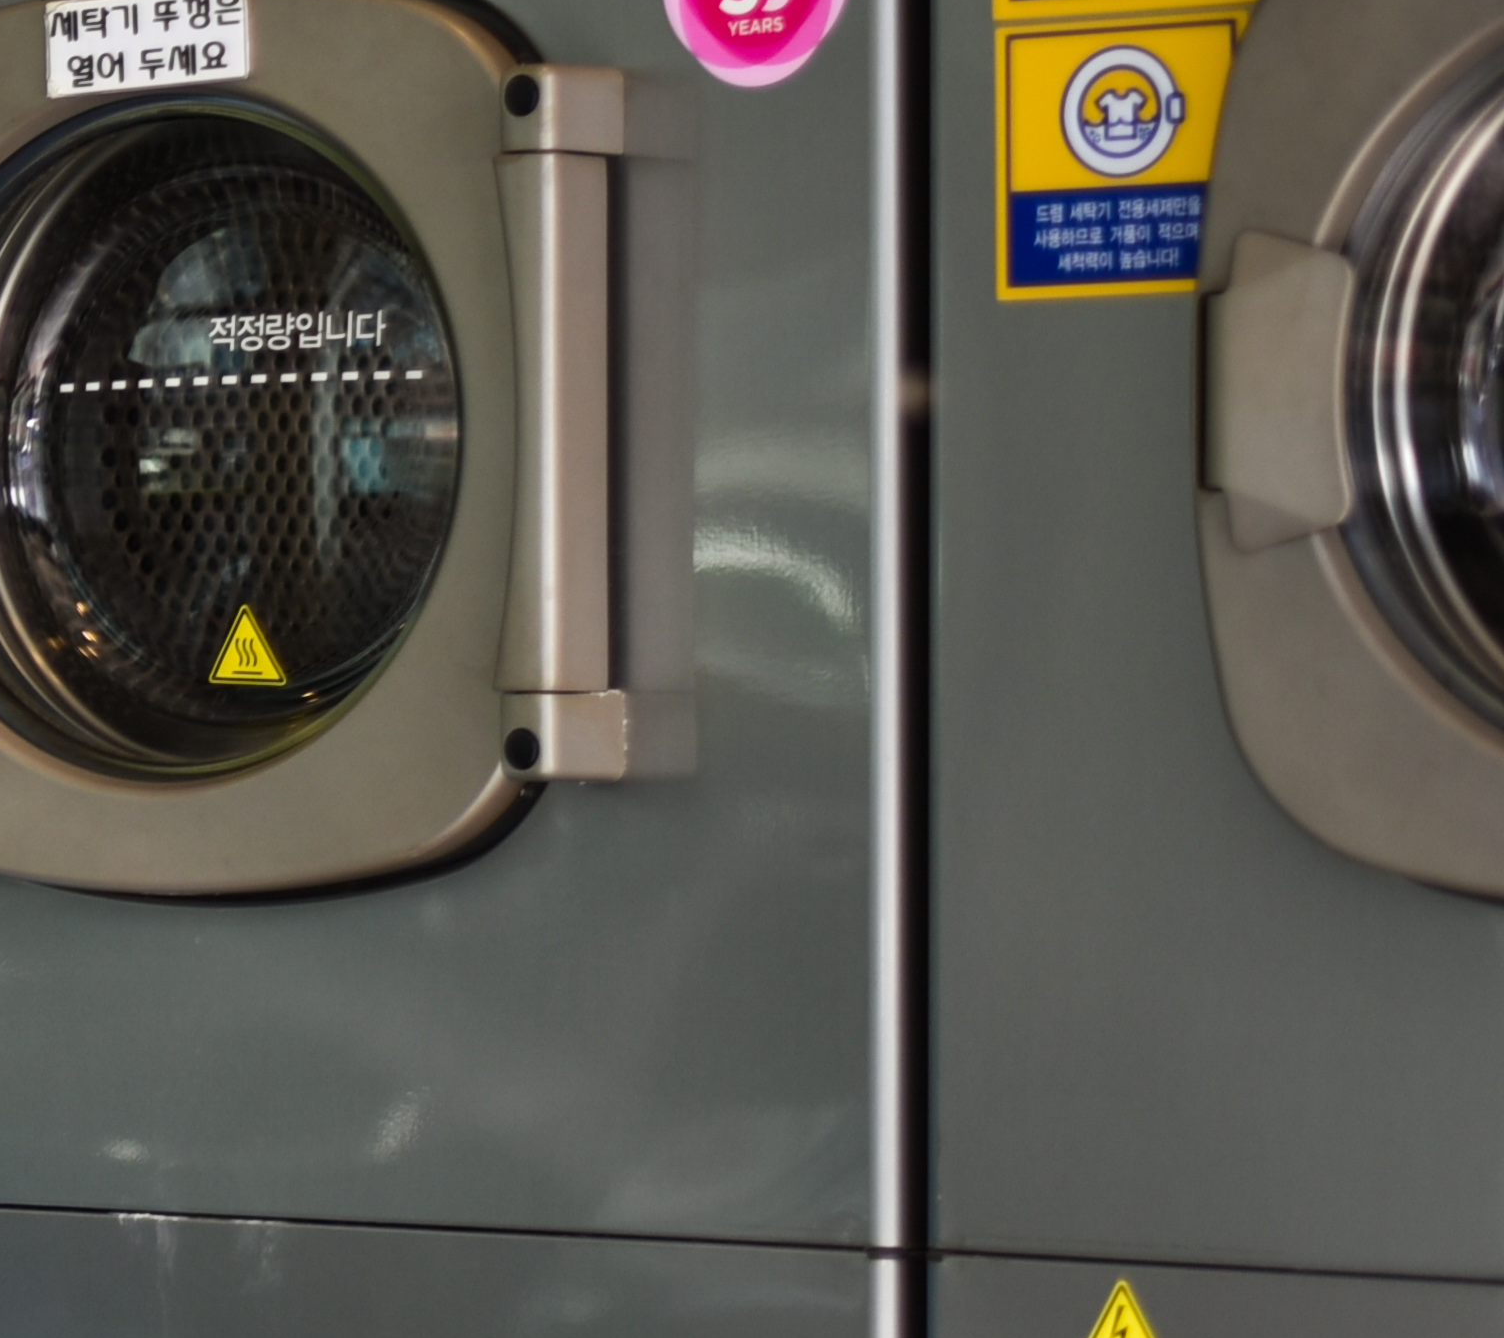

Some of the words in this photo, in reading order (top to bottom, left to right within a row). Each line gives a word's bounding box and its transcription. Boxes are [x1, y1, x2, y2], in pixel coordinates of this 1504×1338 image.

[48, 1, 141, 43] 세탁기
[727, 16, 785, 38] YEARS
[66, 51, 127, 89] 열어
[138, 39, 228, 79] 두세요
[207, 308, 388, 352] 적정량입니다
